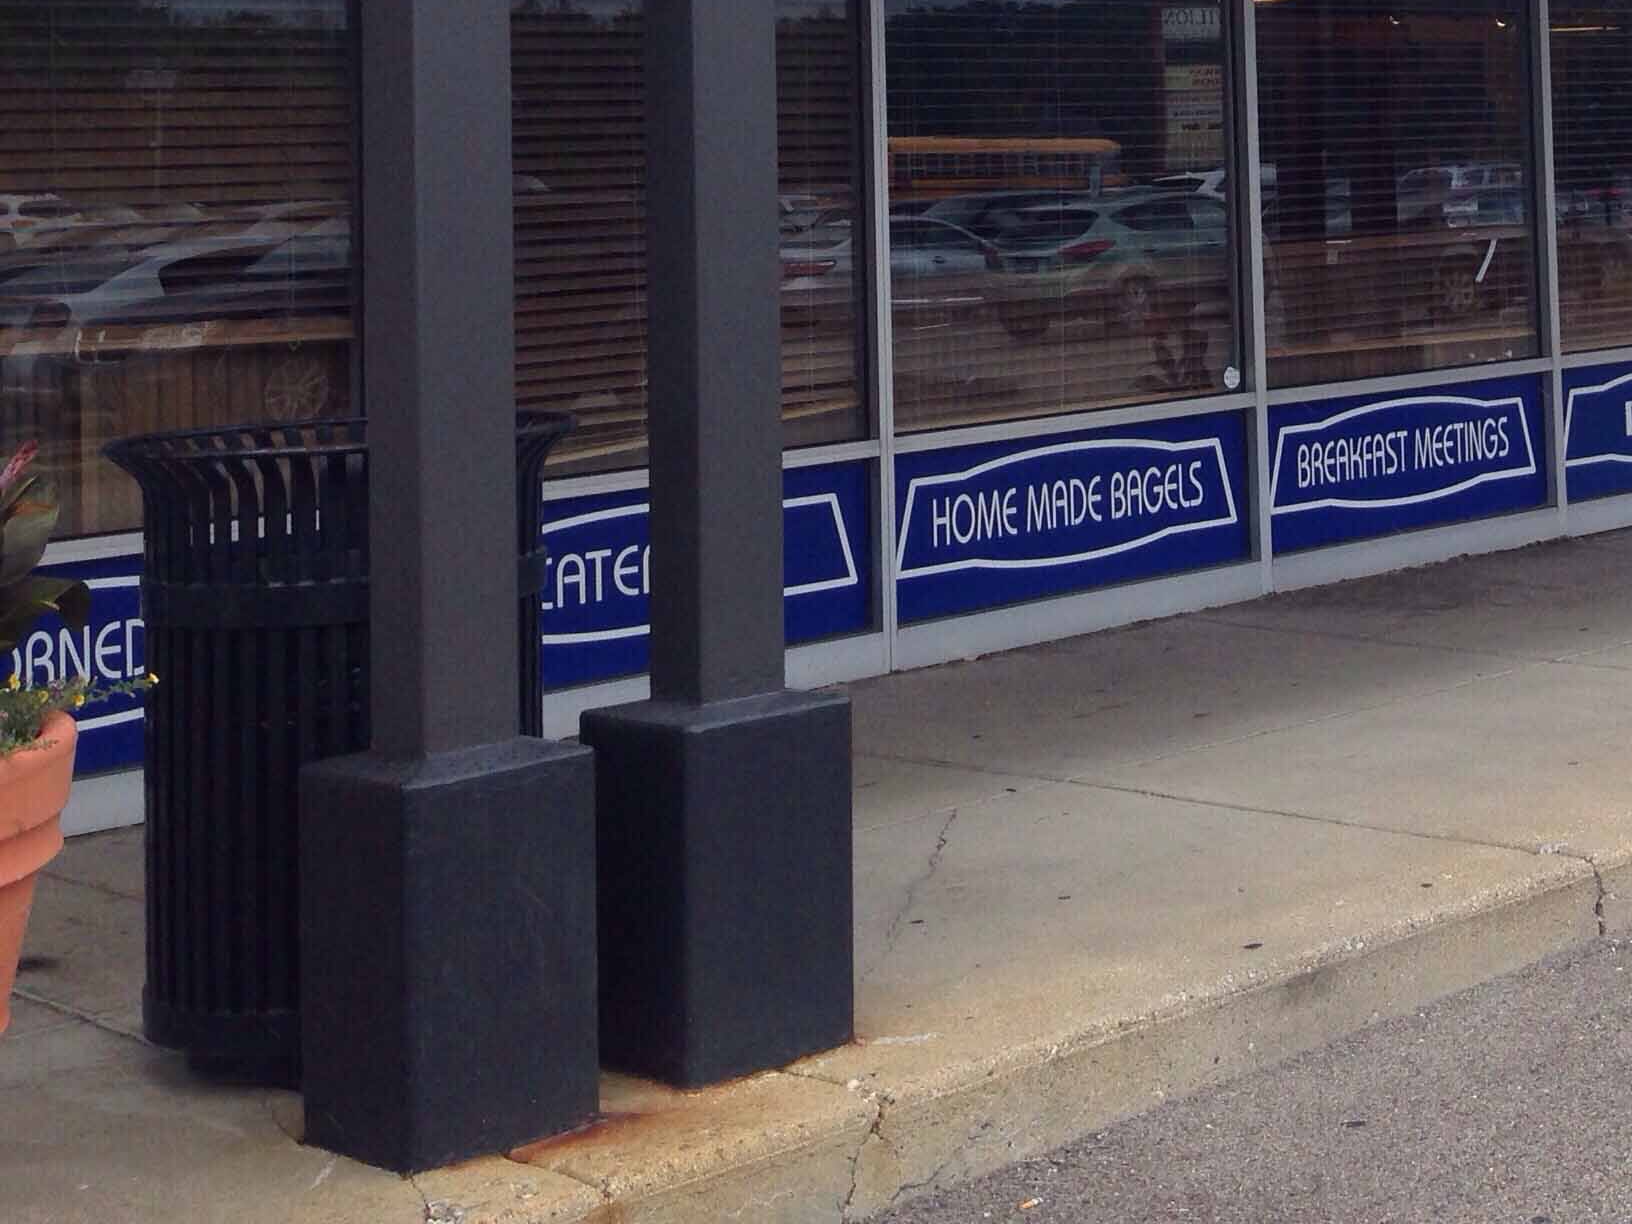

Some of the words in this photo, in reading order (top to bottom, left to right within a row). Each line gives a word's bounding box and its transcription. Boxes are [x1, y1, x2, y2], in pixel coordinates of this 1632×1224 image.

[1297, 430, 1408, 489] BREAKFAST
[1414, 416, 1510, 470] MEETINGS
[932, 487, 1018, 548] HOME
[1026, 475, 1103, 533] MADE
[1110, 460, 1204, 520] BAGELS
